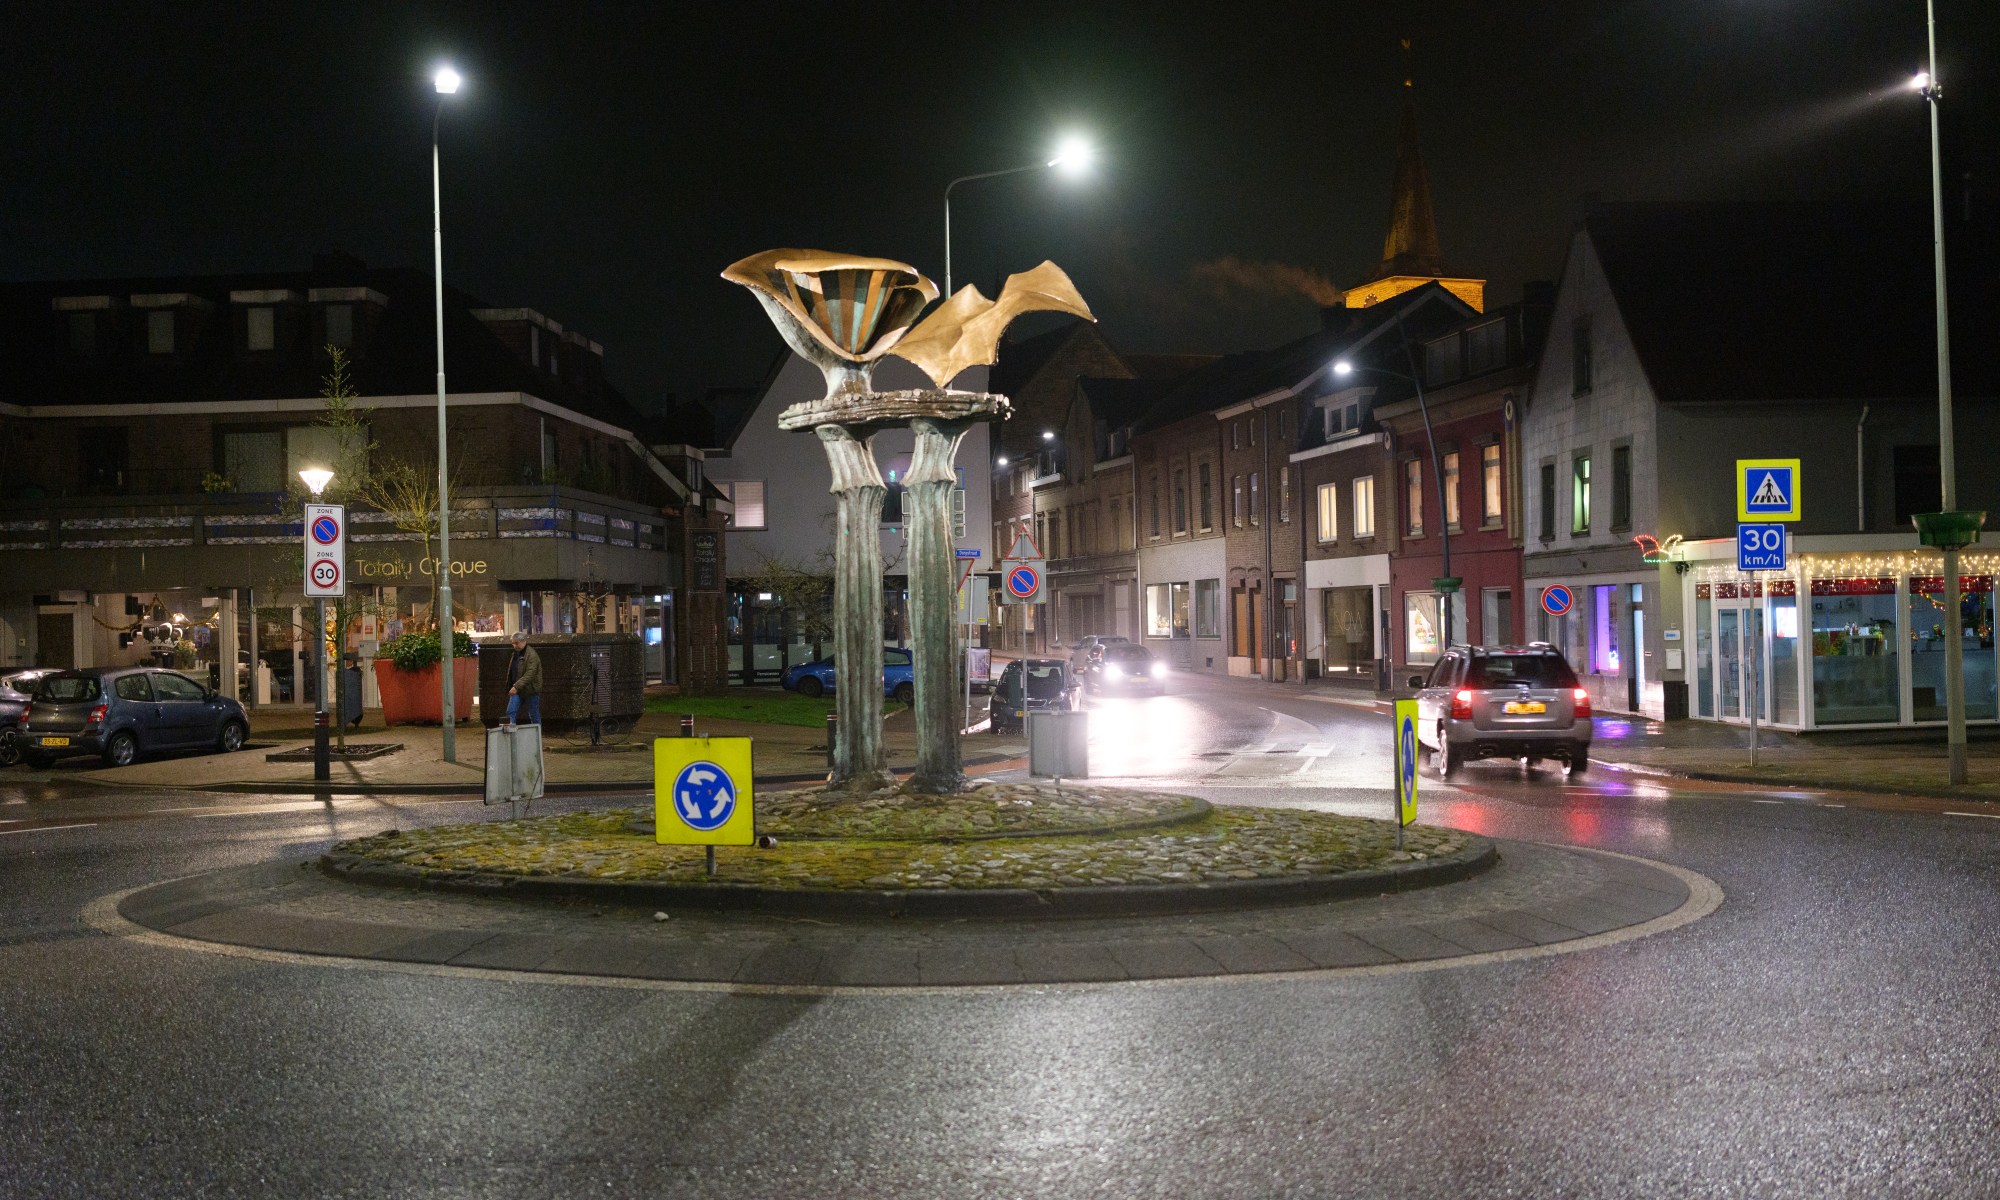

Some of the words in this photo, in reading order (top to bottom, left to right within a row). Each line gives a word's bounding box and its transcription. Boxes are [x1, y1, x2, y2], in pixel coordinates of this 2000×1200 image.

[1744, 530, 1780, 550] 30
[1744, 554, 1780, 565] km/h
[316, 568, 334, 579] 30
[420, 558, 488, 578] Chque
